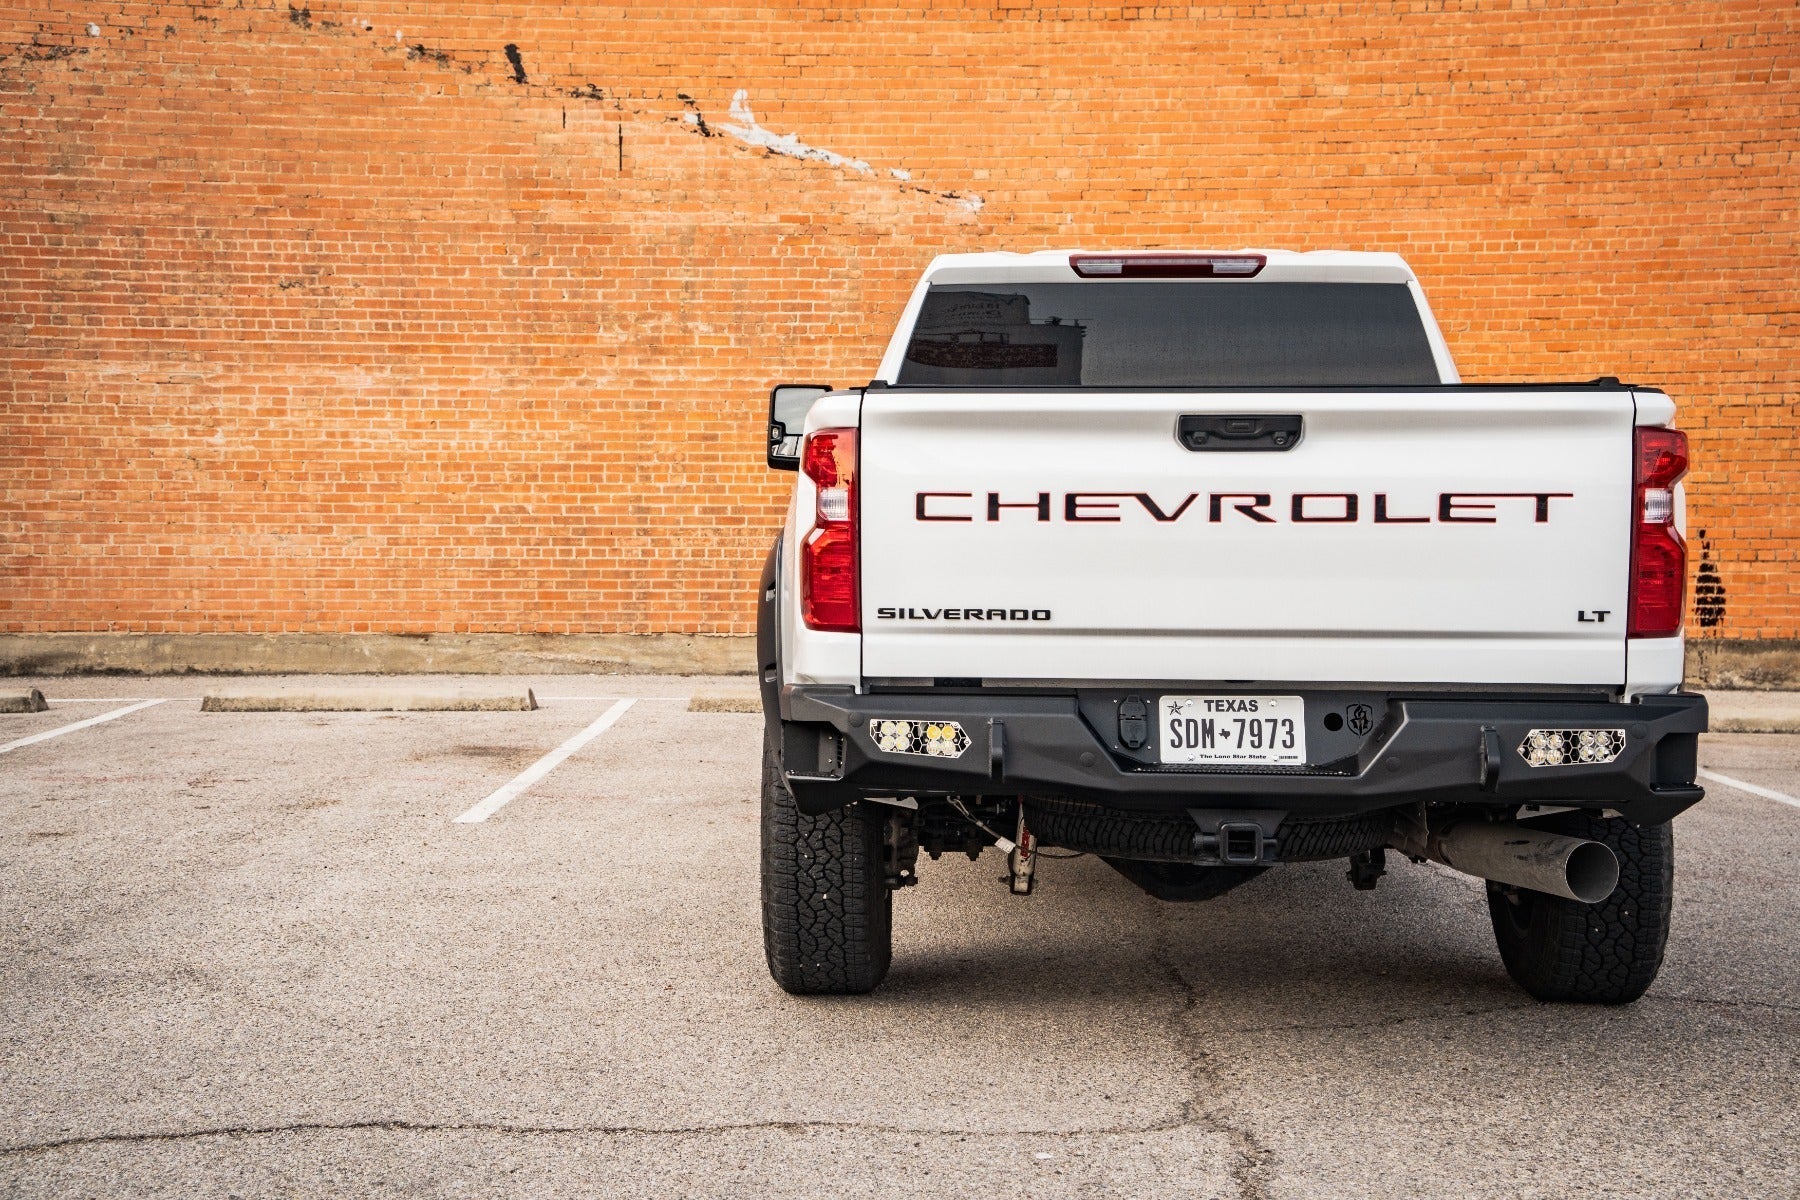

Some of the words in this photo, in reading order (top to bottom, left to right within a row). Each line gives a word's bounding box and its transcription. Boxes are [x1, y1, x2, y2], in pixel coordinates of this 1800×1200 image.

[915, 491, 1575, 524] CHEVROLET
[877, 607, 1052, 620] SILVERADO
[1577, 610, 1611, 623] LT
[1203, 699, 1259, 713] TEXAS
[1169, 718, 1215, 749] SDM
[1232, 718, 1295, 749] 7973
